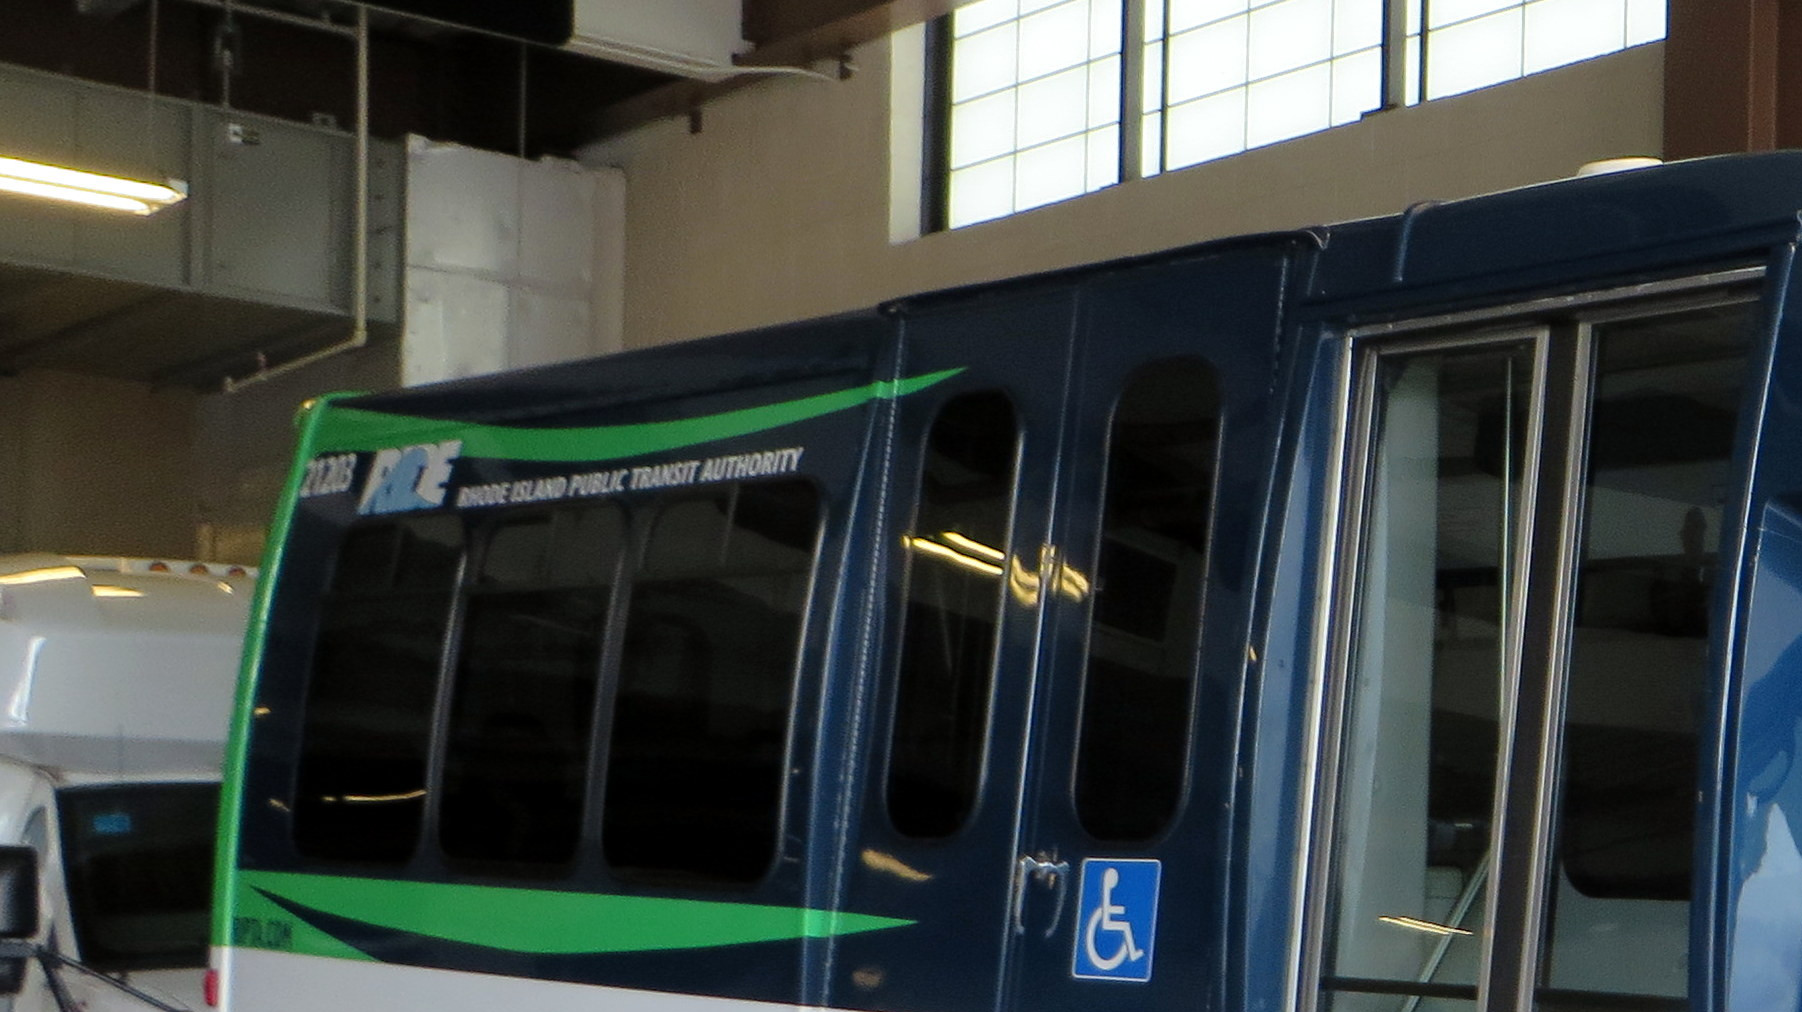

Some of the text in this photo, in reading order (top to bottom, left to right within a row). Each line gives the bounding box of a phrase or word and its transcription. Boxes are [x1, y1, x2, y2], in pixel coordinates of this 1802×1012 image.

[300, 453, 357, 498] 21203
[357, 440, 462, 515] RIDE
[457, 446, 804, 507] RHODE ISLAND PUBLIC TRANSIT AUTHORITY
